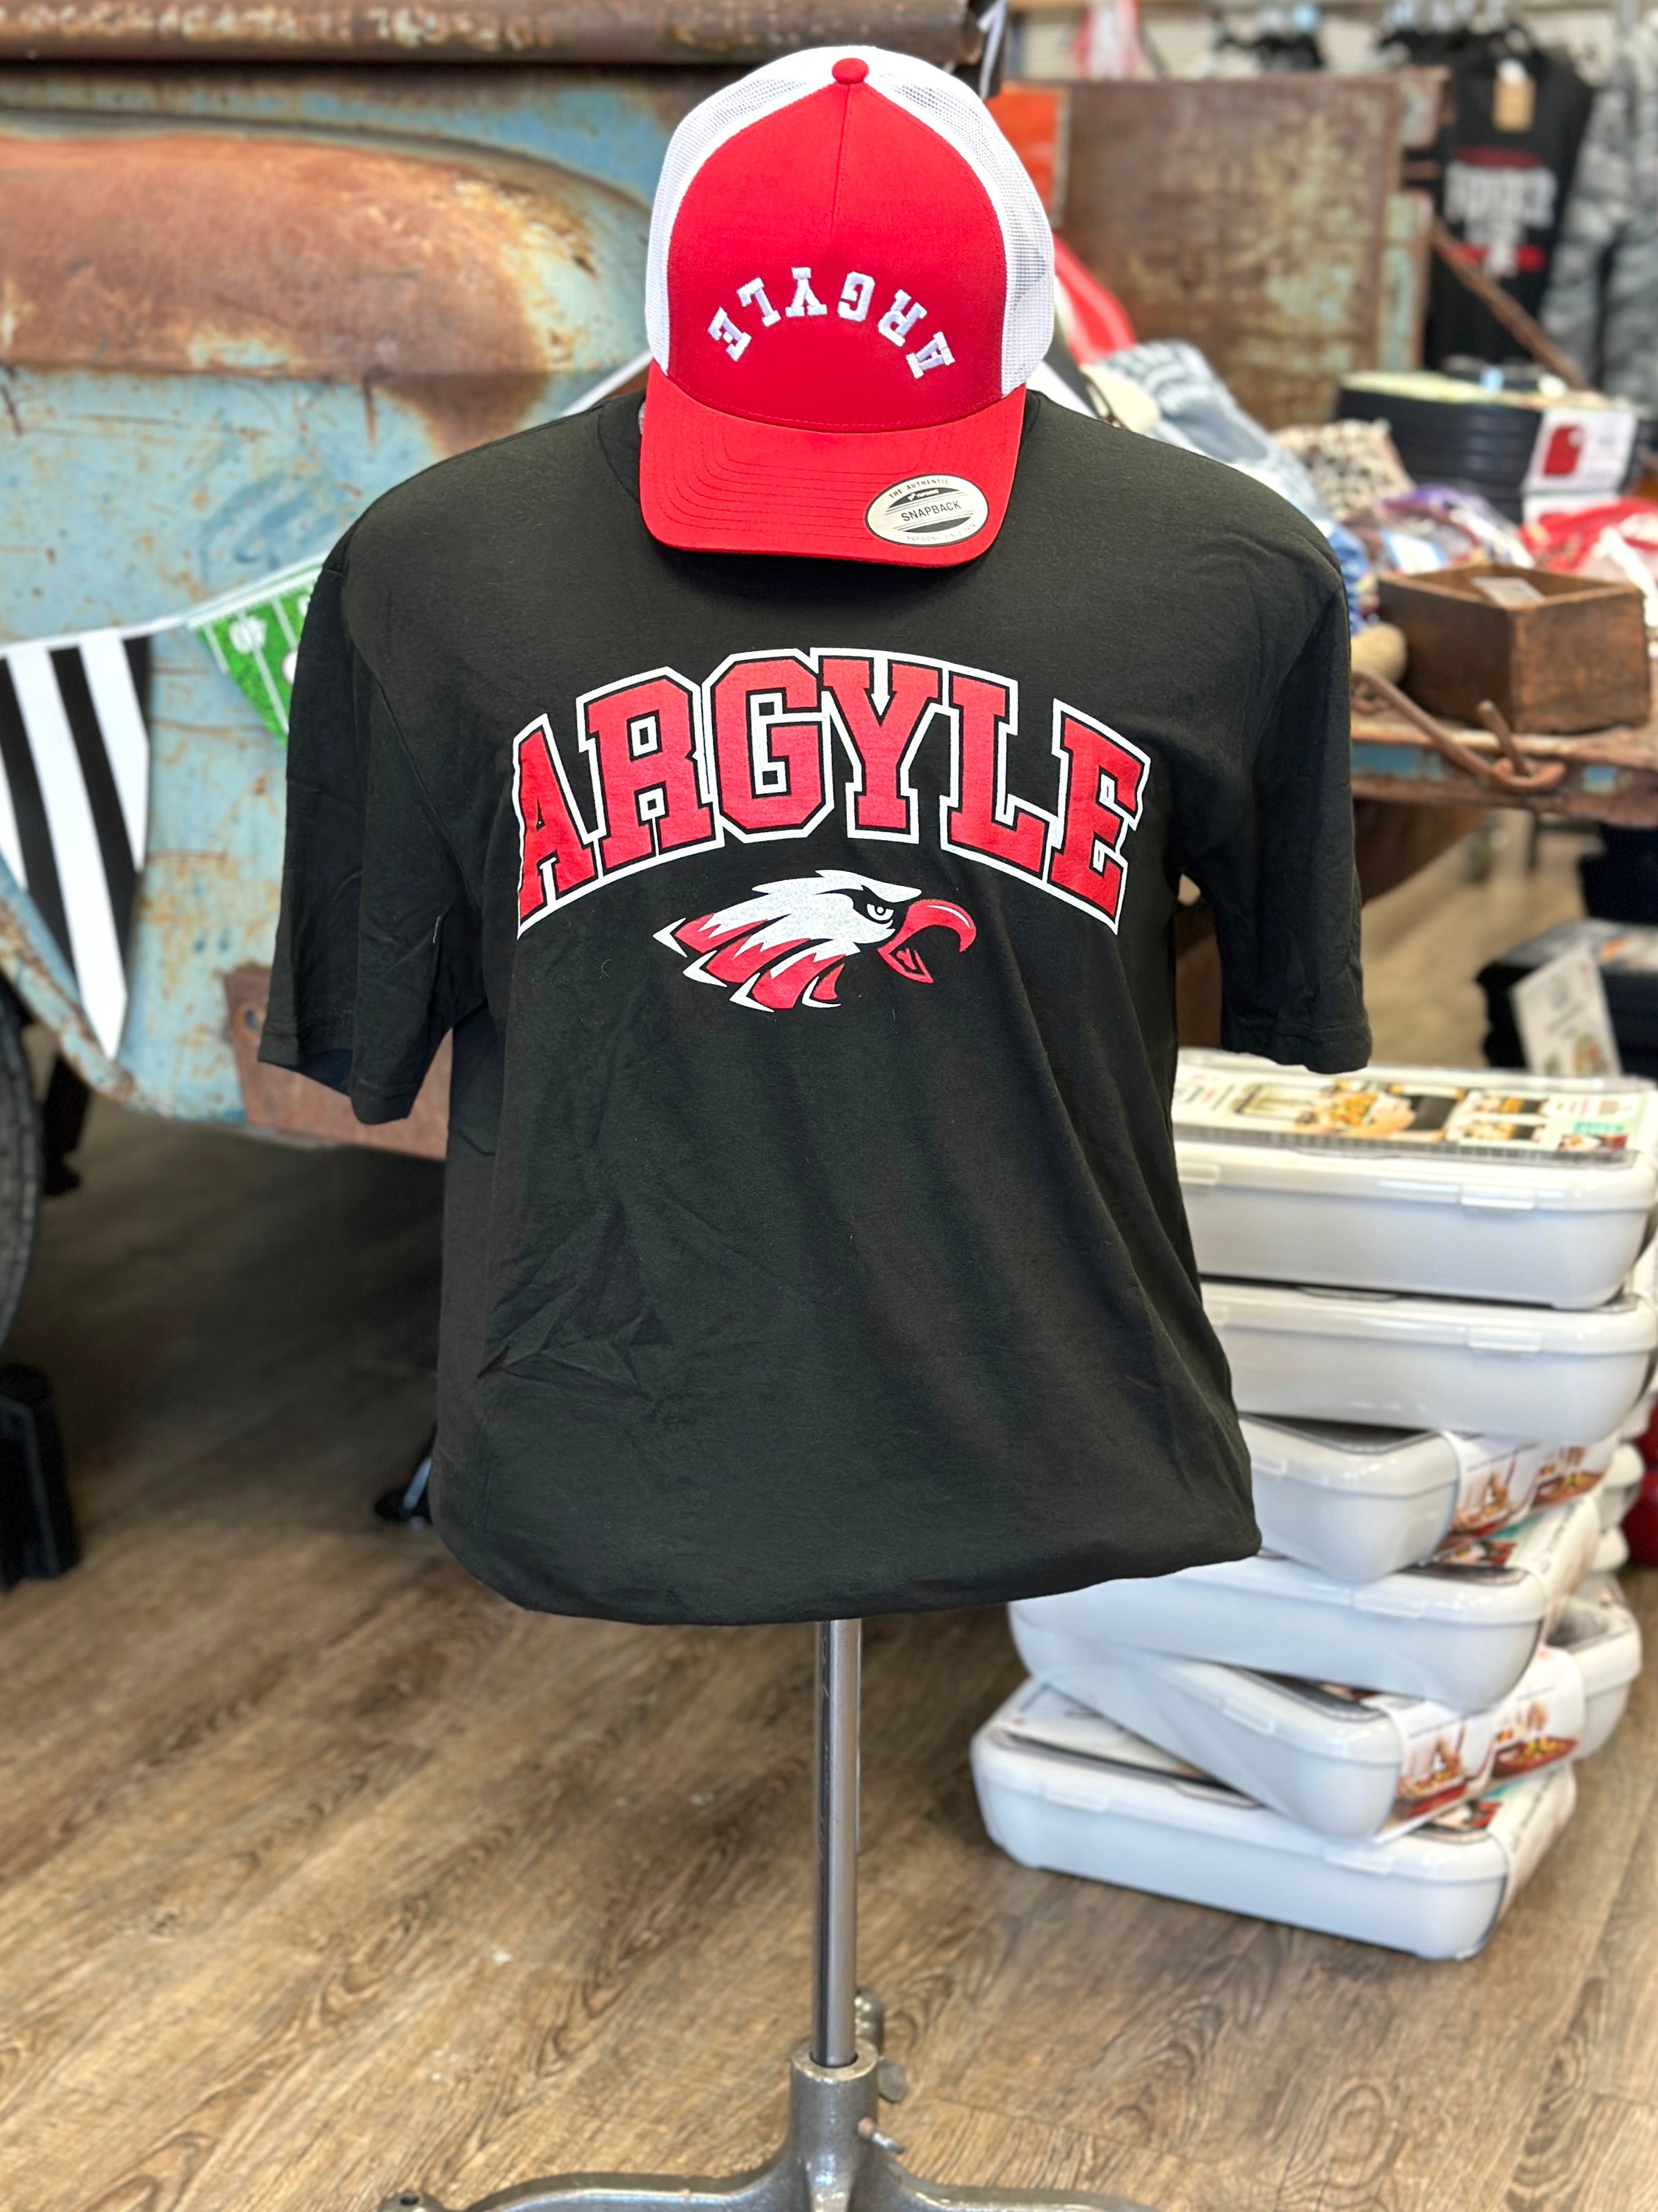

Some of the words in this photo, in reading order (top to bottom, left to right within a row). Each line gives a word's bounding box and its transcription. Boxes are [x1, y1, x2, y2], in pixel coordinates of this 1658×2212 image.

[707, 267, 955, 379] ARGYLE
[889, 489, 903, 499] THE
[906, 479, 949, 490] AUTHENTIC
[901, 500, 962, 521] SNAPBACK
[512, 647, 1151, 940] ARGYLE
